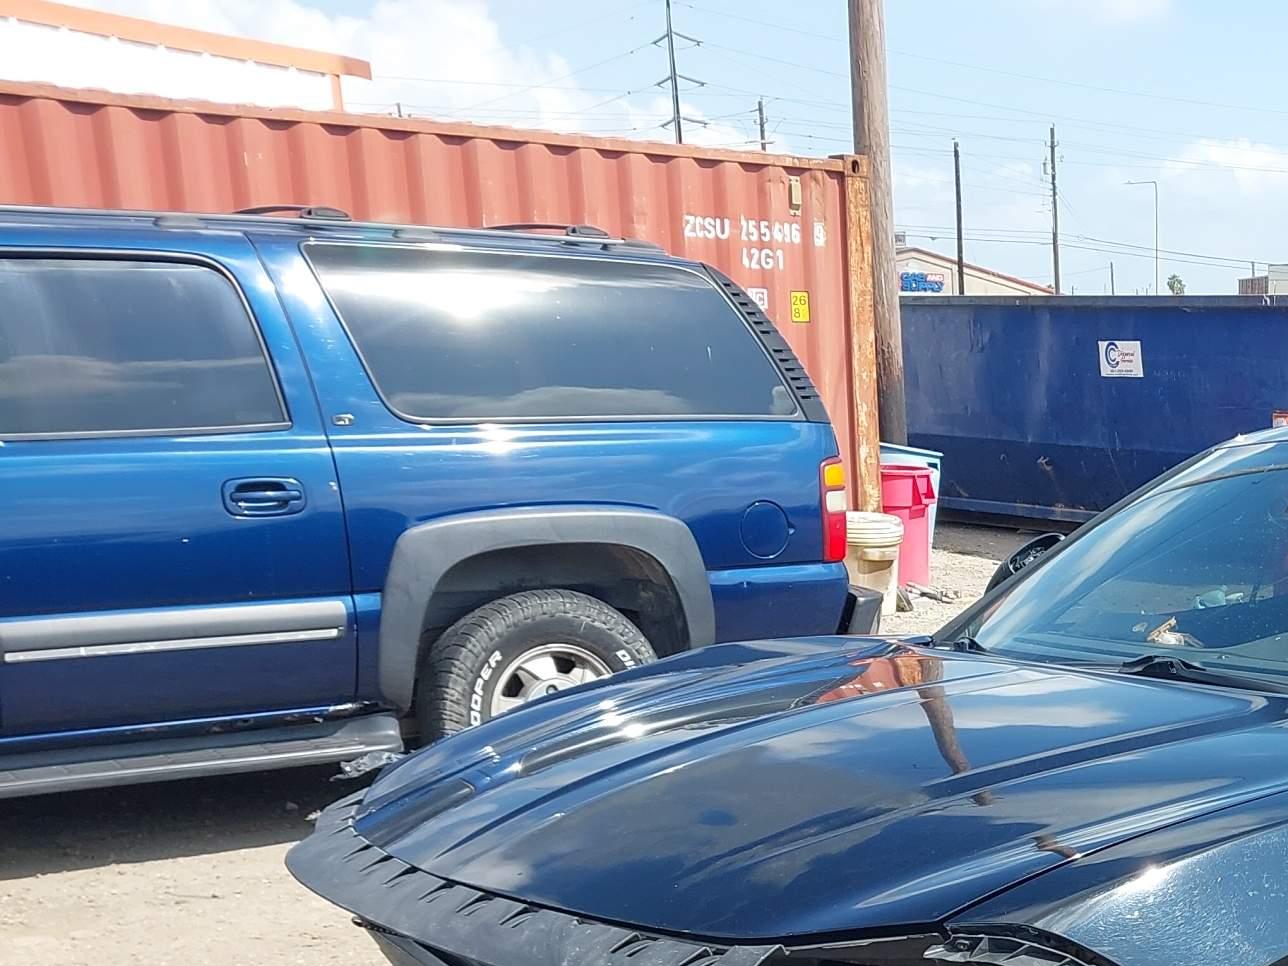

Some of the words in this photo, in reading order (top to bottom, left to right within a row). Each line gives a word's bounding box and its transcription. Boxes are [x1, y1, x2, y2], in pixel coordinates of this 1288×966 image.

[684, 215, 731, 240] ZCSU
[926, 272, 945, 283] AND
[901, 281, 945, 293] SUPPLY
[470, 649, 503, 726] OOPER
